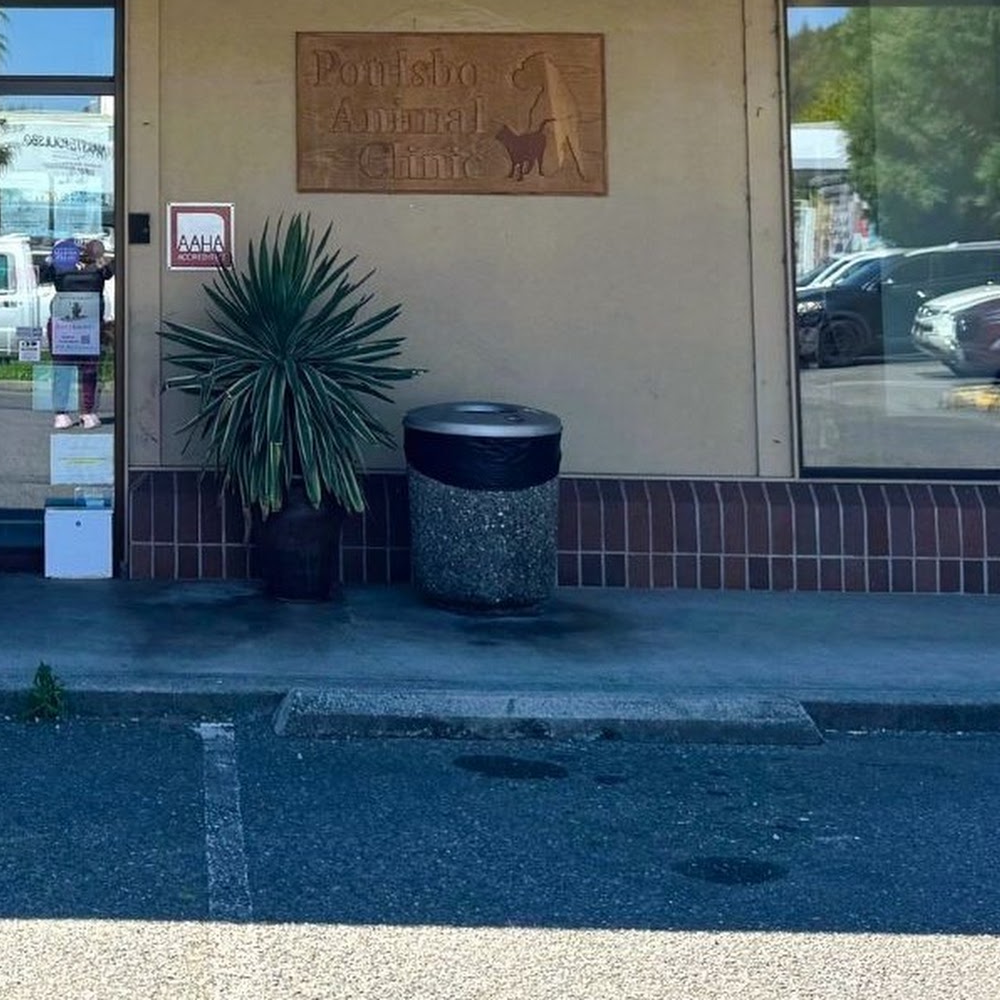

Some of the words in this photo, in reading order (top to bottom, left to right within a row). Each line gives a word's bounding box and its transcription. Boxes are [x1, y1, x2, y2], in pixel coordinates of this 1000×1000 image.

[312, 48, 478, 89] Poulsbo
[329, 97, 486, 134] Animal
[358, 141, 479, 181] Clinic
[178, 234, 225, 252] AAHA
